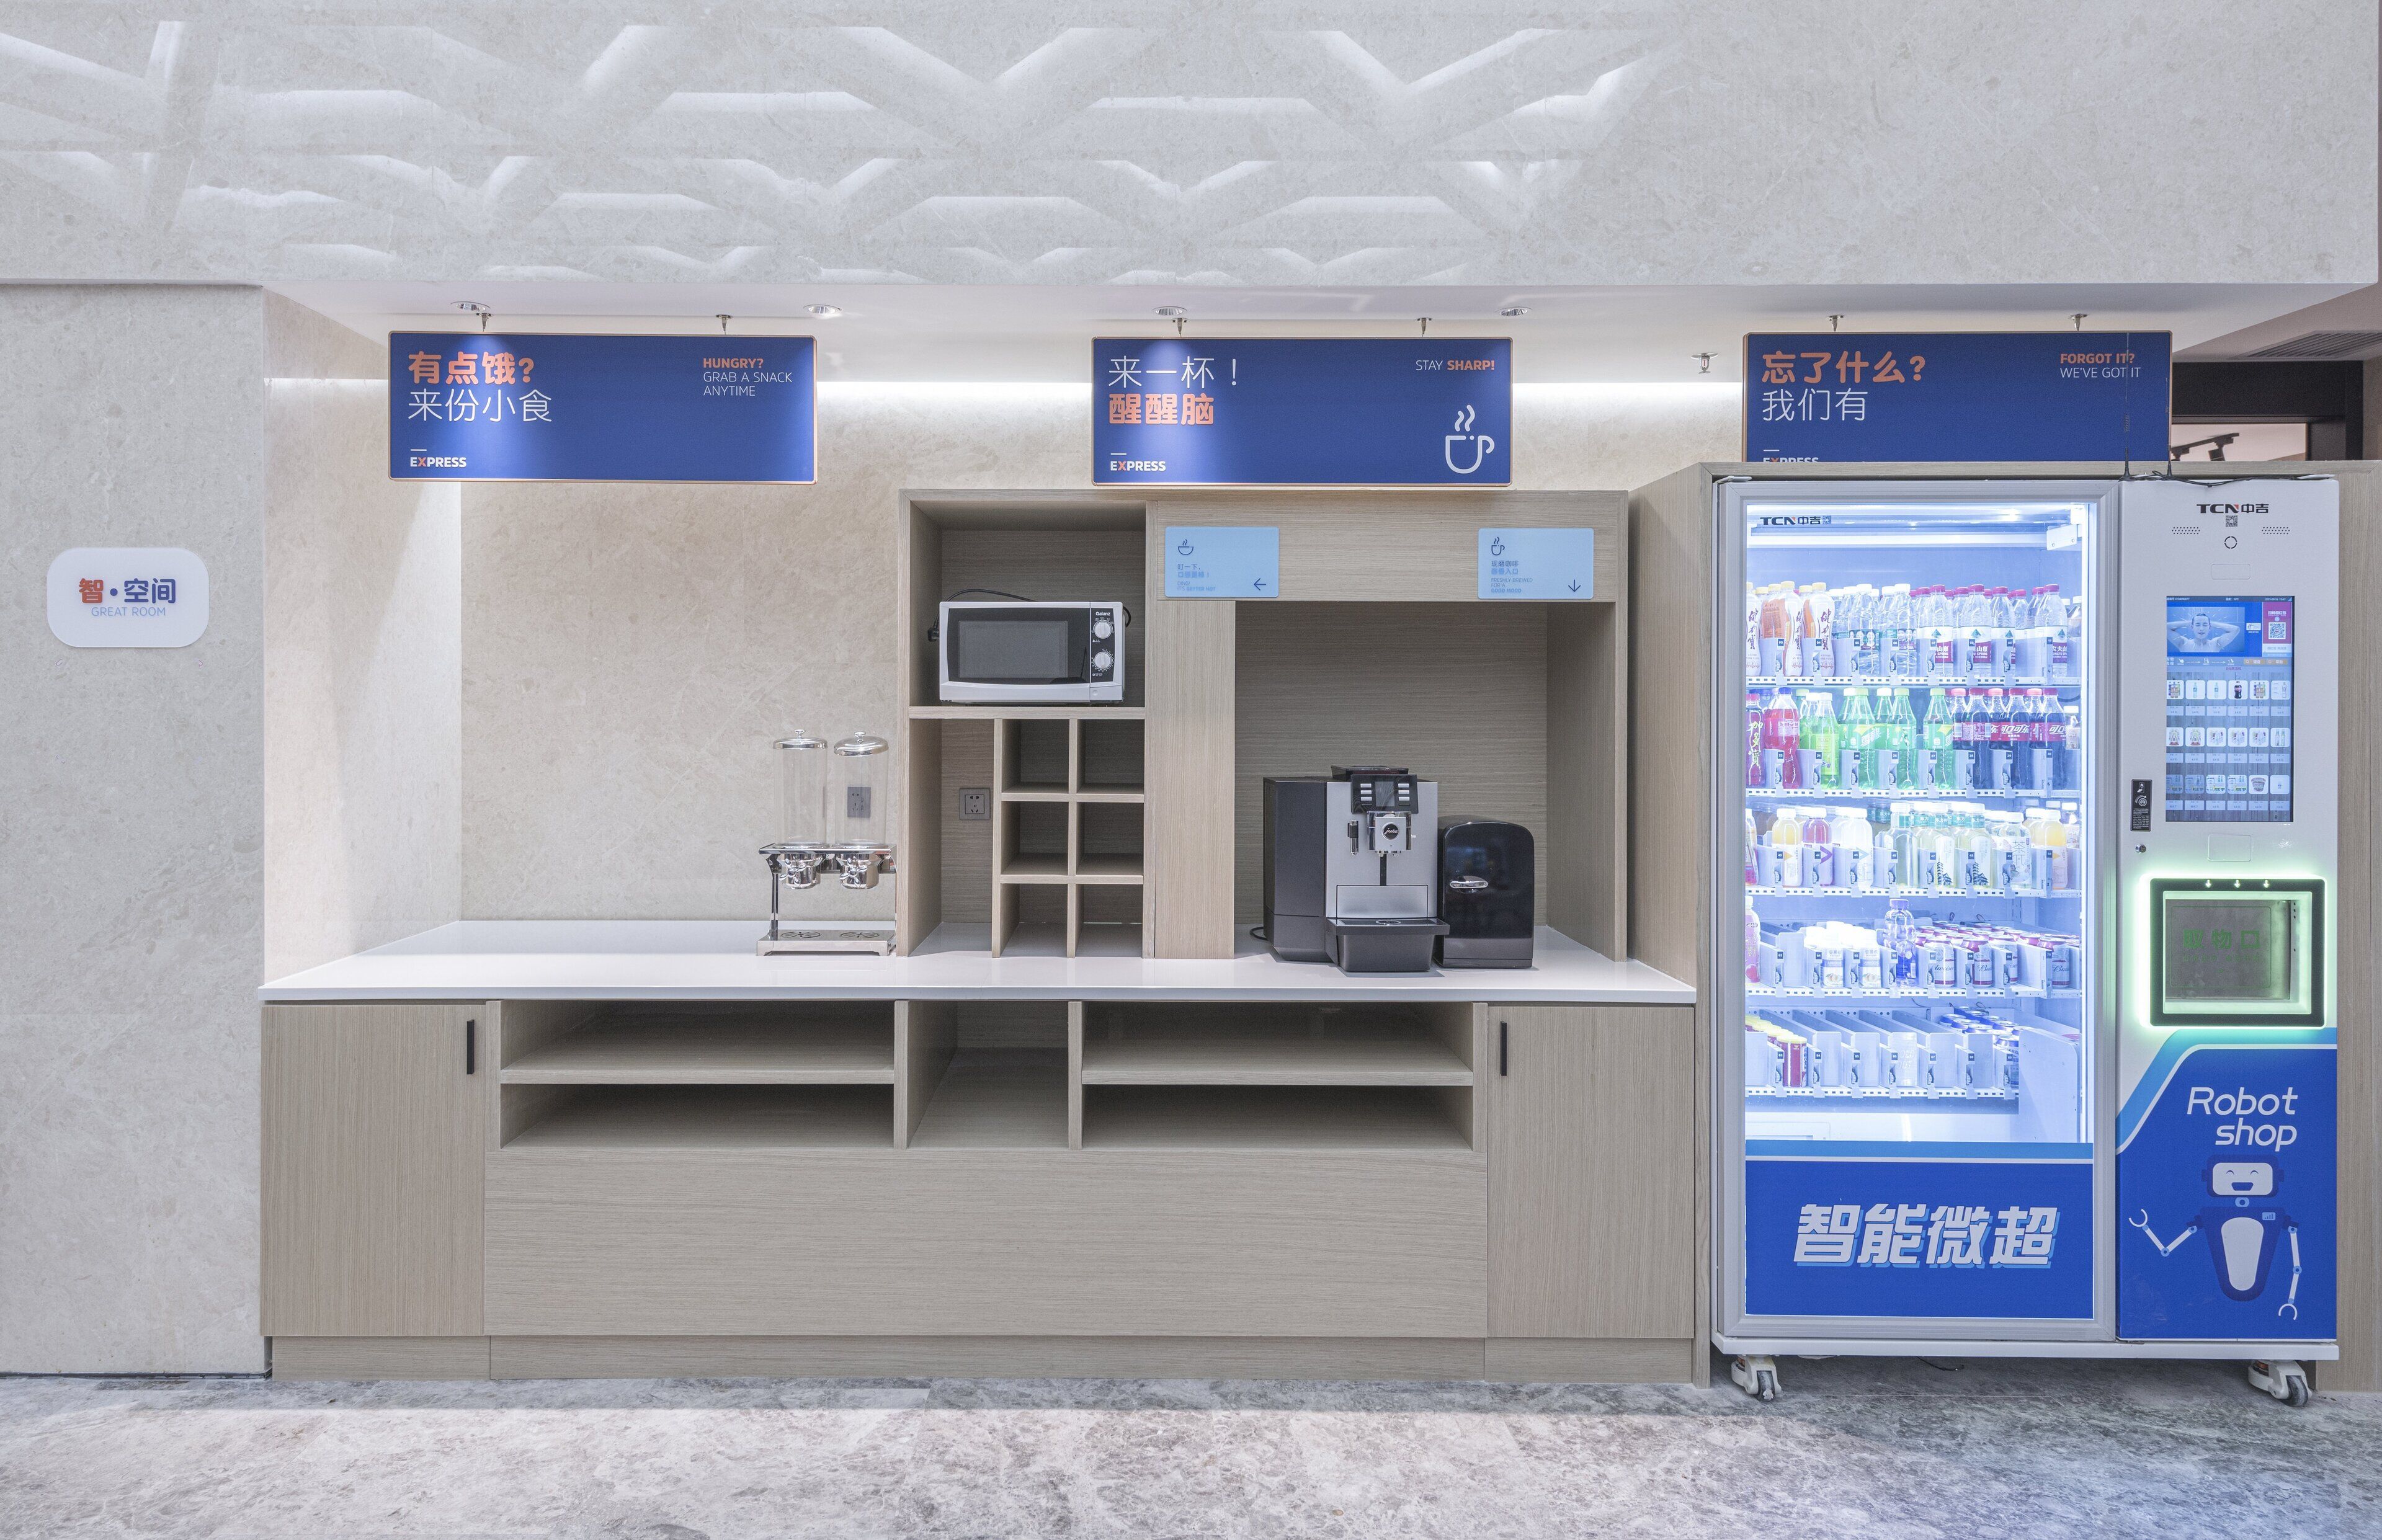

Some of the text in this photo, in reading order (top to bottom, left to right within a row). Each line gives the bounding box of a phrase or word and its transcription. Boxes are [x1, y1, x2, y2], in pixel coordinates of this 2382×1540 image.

[703, 358, 764, 368] HUNGRY?
[2061, 353, 2135, 364] FORGOT IT?
[408, 352, 534, 385] 有点饿?
[1416, 360, 1495, 370] STAY SHARP!
[1762, 350, 1925, 383] 忘了什么?
[703, 372, 792, 383] GRAB A SNACK
[2061, 367, 2141, 378] WE'VE GOT IT
[703, 386, 755, 396] ANYTIME
[408, 388, 551, 422] 来份小食
[1109, 393, 1214, 425] 醒醒脑
[1762, 388, 1868, 421] 我们有
[411, 457, 467, 467] EXPRESS
[1110, 461, 1166, 471] EXPRESS
[91, 607, 166, 616] GREAT ROOM
[2049, 724, 2066, 734] 可口
[2187, 1087, 2298, 1115] Robot
[2216, 1118, 2297, 1152] shop
[1793, 1203, 2059, 1268] 智能微超
